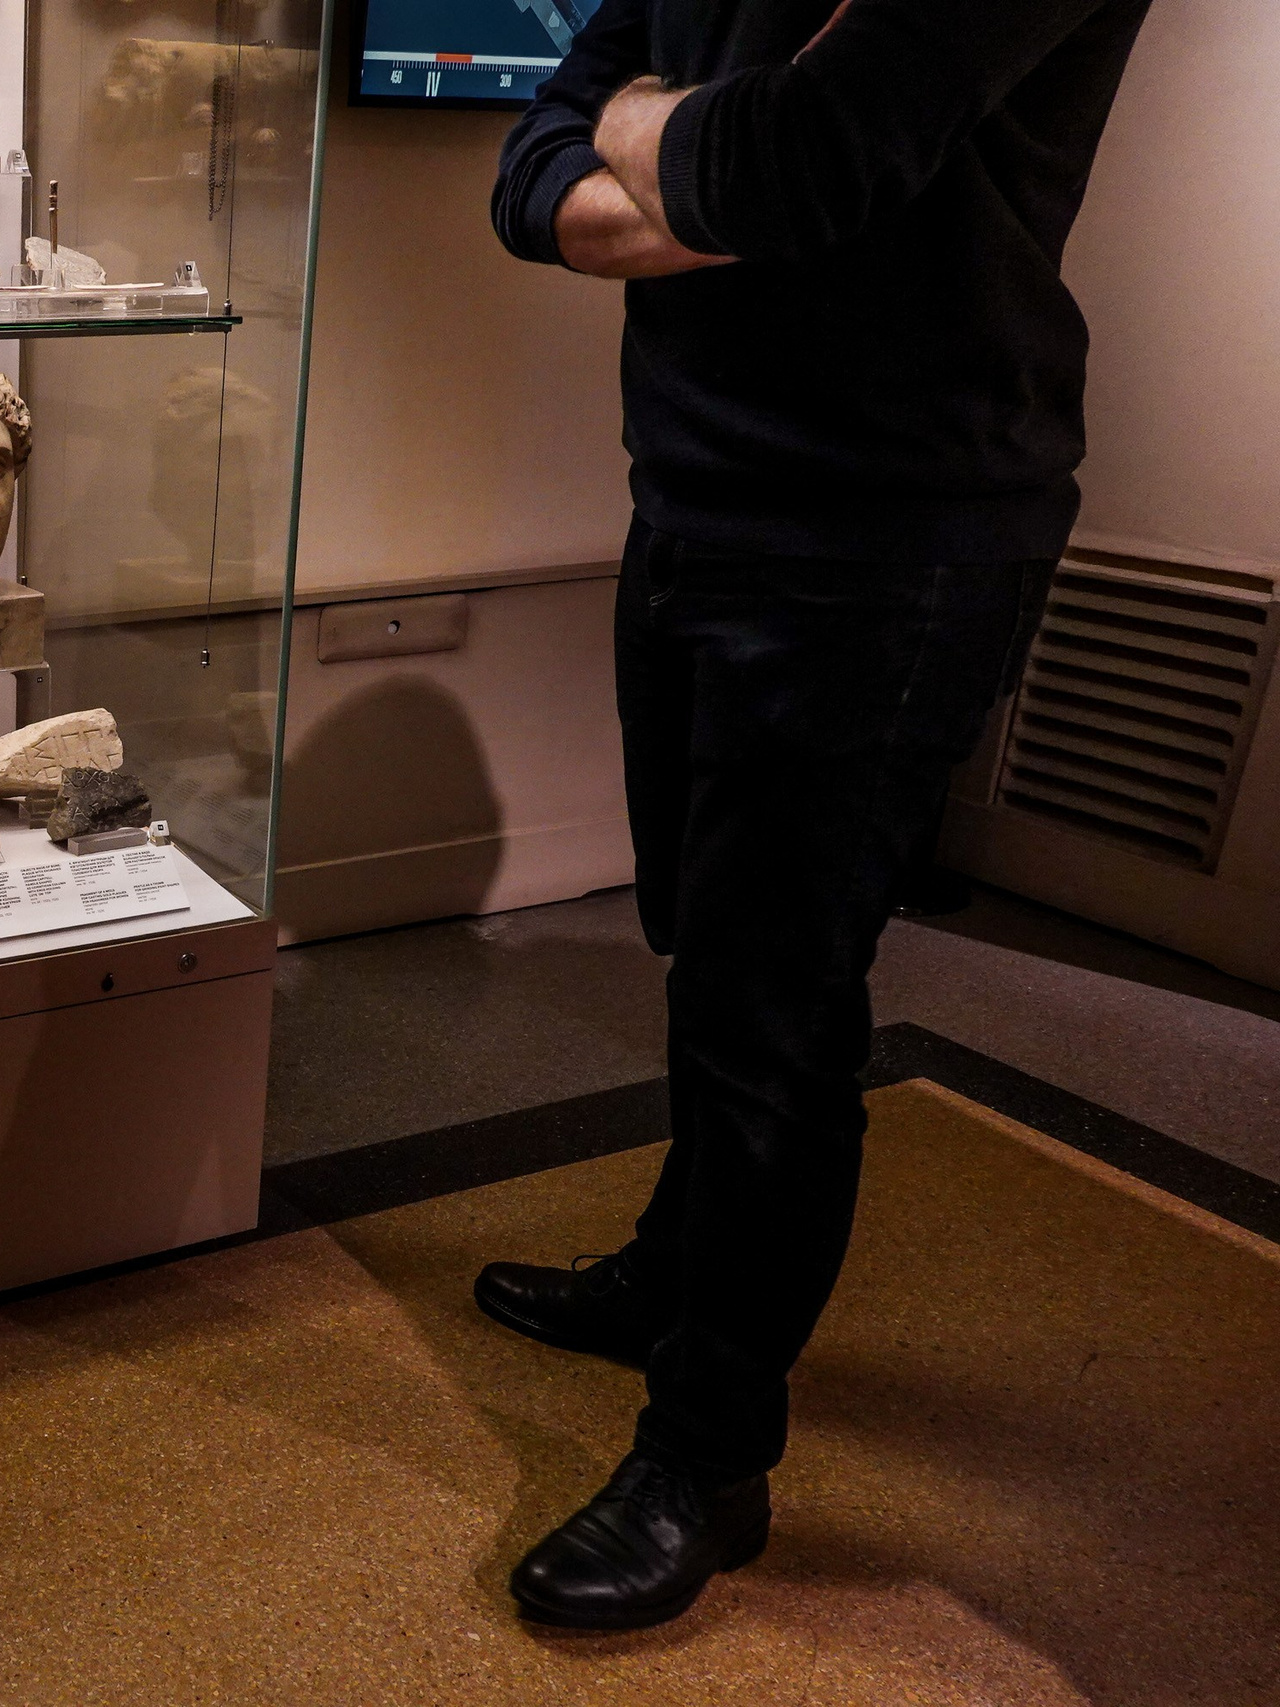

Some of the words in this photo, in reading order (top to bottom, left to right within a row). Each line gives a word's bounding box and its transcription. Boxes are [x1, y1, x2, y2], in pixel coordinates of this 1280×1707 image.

[390, 70, 403, 84] 450
[425, 71, 441, 97] IV
[499, 74, 512, 88] 300
